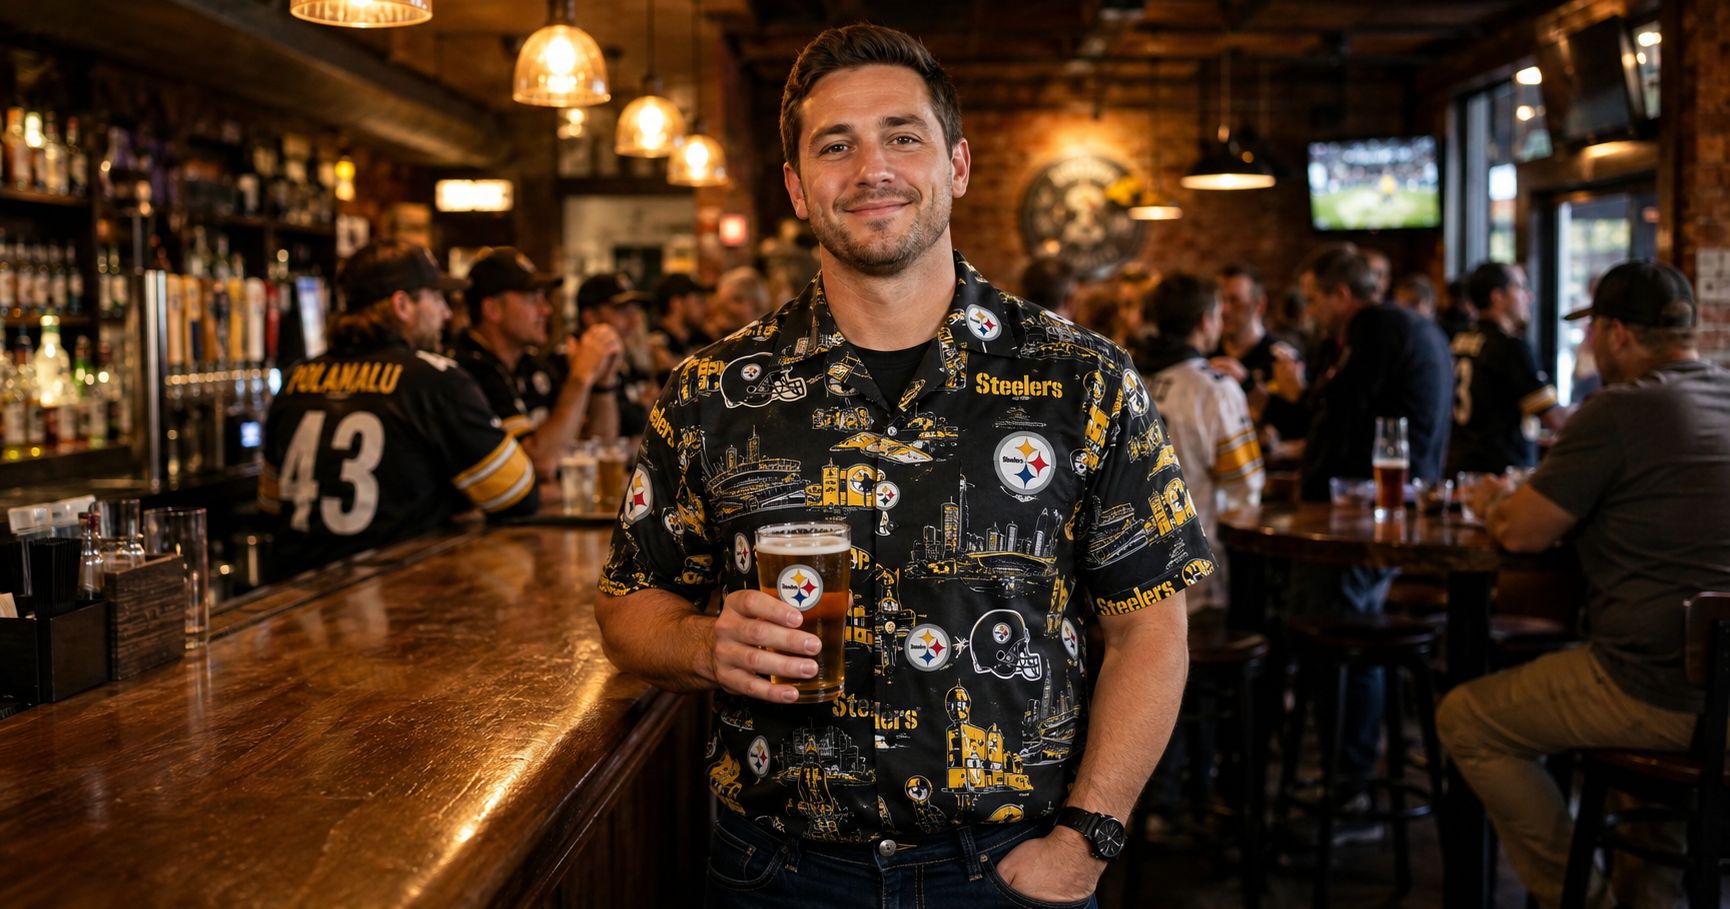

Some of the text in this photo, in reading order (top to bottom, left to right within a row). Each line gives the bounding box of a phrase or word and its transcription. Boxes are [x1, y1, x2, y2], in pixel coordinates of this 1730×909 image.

[975, 372, 1064, 399] Steelers
[278, 411, 385, 535] 43
[1096, 579, 1177, 617] Steelers
[831, 692, 919, 730] Stelers
